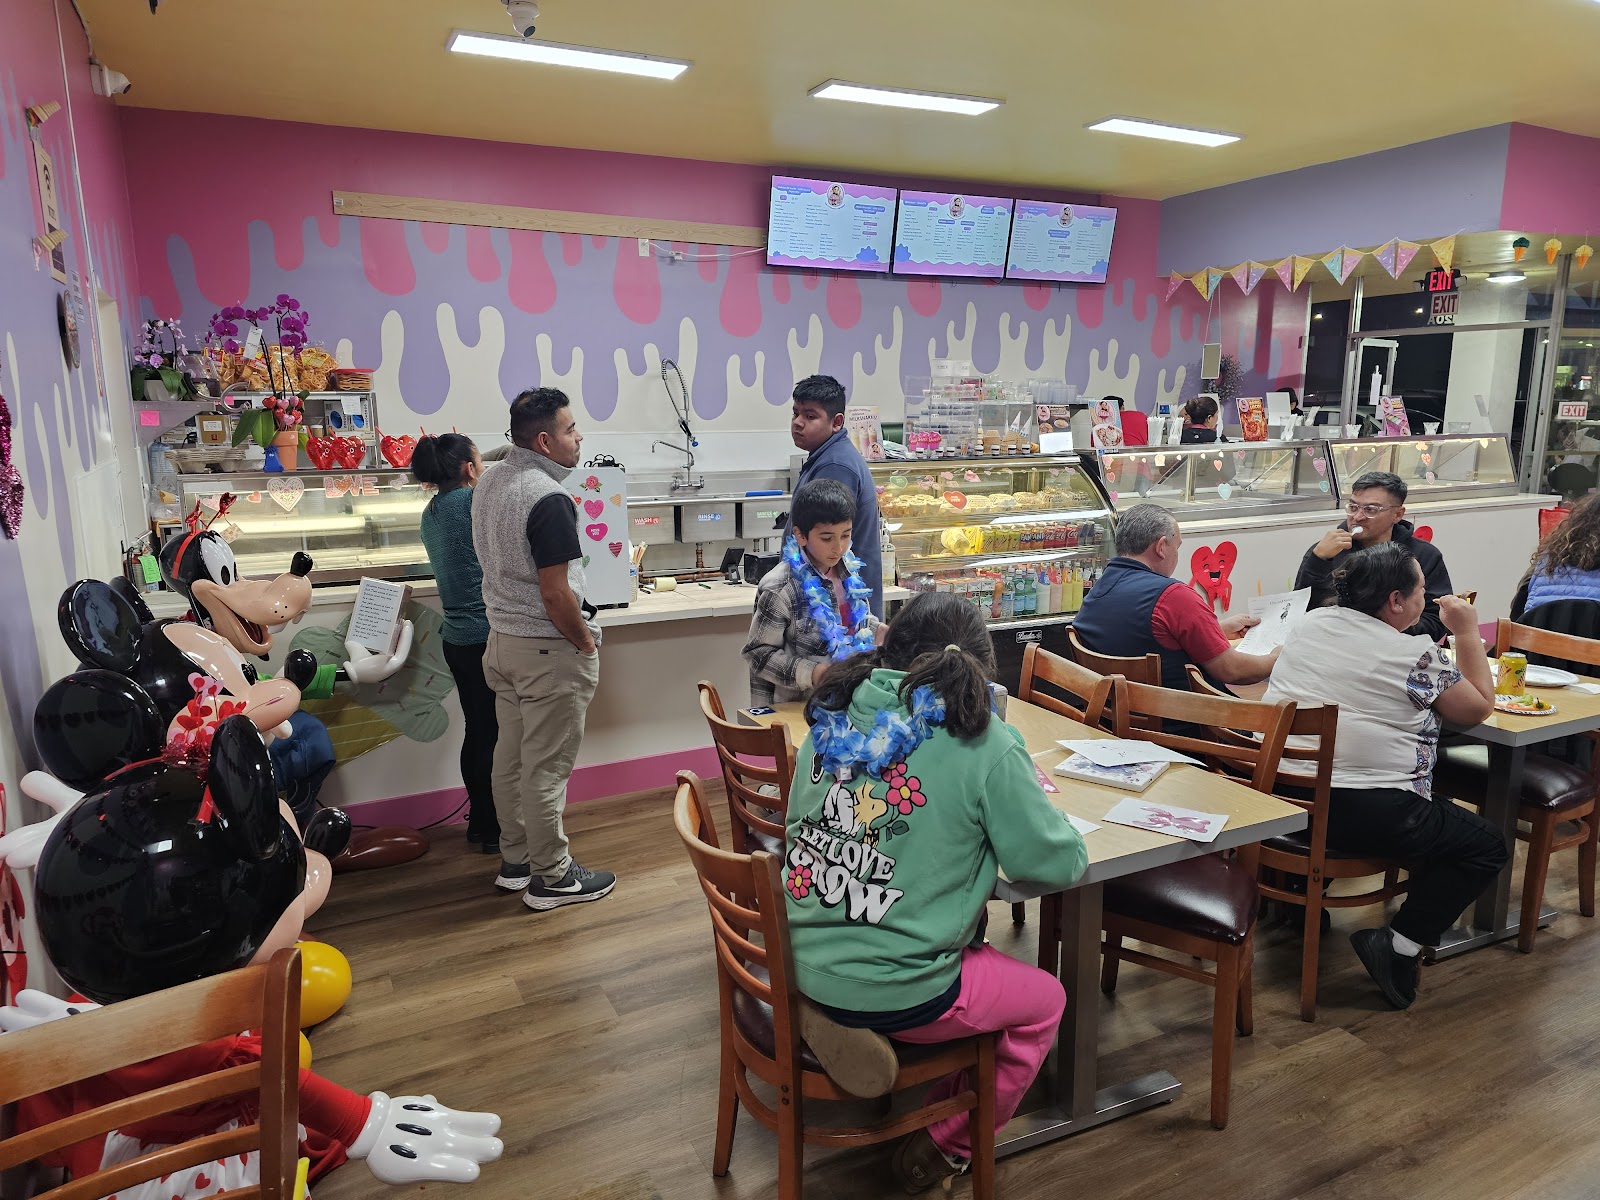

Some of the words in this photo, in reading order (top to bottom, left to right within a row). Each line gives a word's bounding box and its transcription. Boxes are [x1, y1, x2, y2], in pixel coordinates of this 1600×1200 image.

[1429, 270, 1454, 291] EXIT
[1432, 294, 1458, 314] EXIT
[1561, 405, 1585, 416] EXIT
[800, 825, 833, 850] LET
[826, 838, 897, 882] LOVE
[790, 839, 903, 923] GROW
